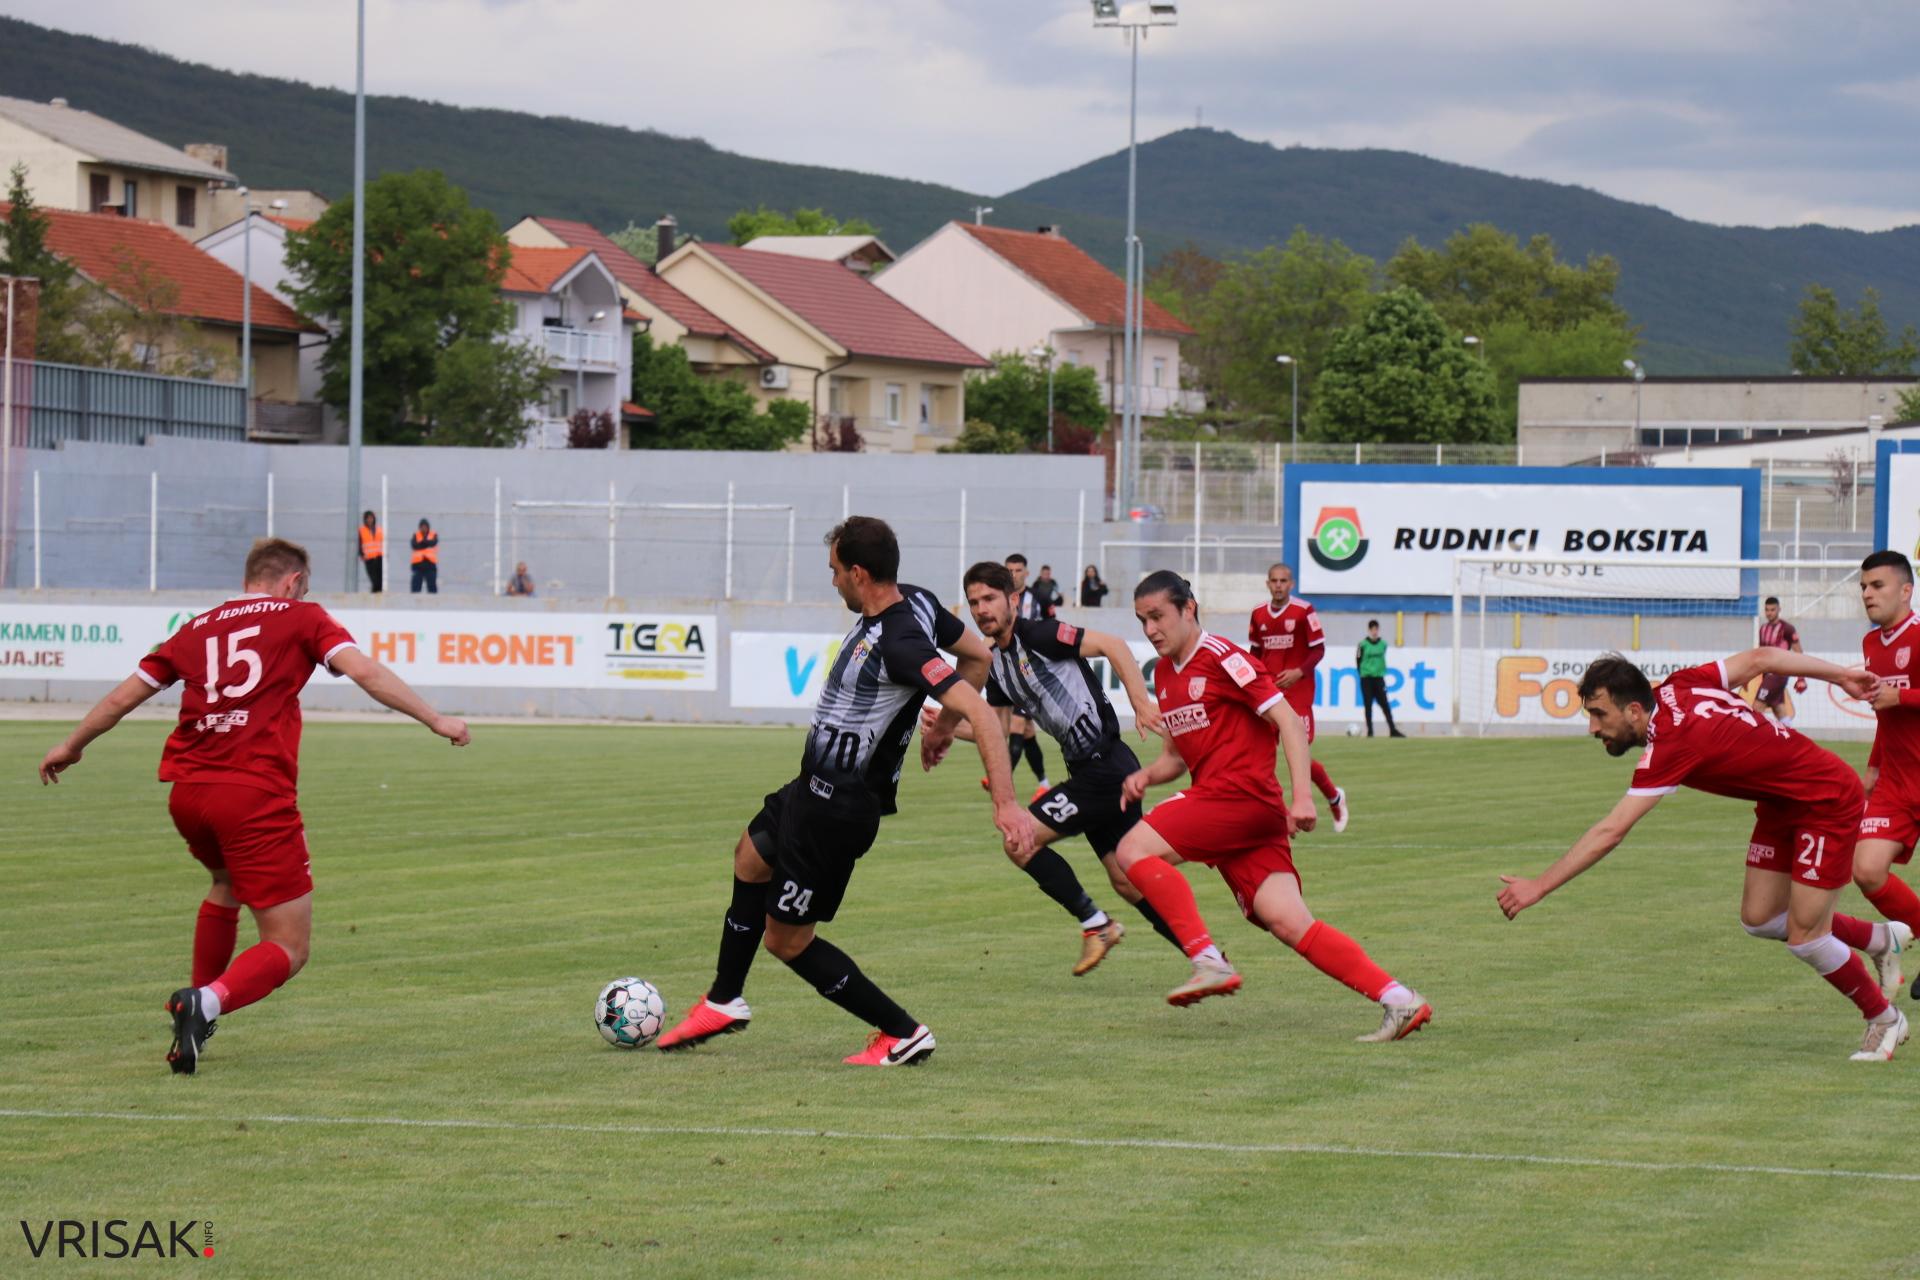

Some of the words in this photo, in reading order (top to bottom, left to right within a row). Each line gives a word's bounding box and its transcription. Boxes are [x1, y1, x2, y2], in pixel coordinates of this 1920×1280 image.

[1394, 527, 1540, 550] RUDNICI
[1563, 529, 1708, 552] BOKSITA
[216, 601, 290, 621] JEDINSTVO
[71, 624, 122, 643] D.O.O.
[204, 624, 263, 703] 15
[438, 634, 574, 665] ERONET
[1041, 793, 1079, 824] 29
[1798, 832, 1825, 867] 21
[777, 880, 814, 917] 24
